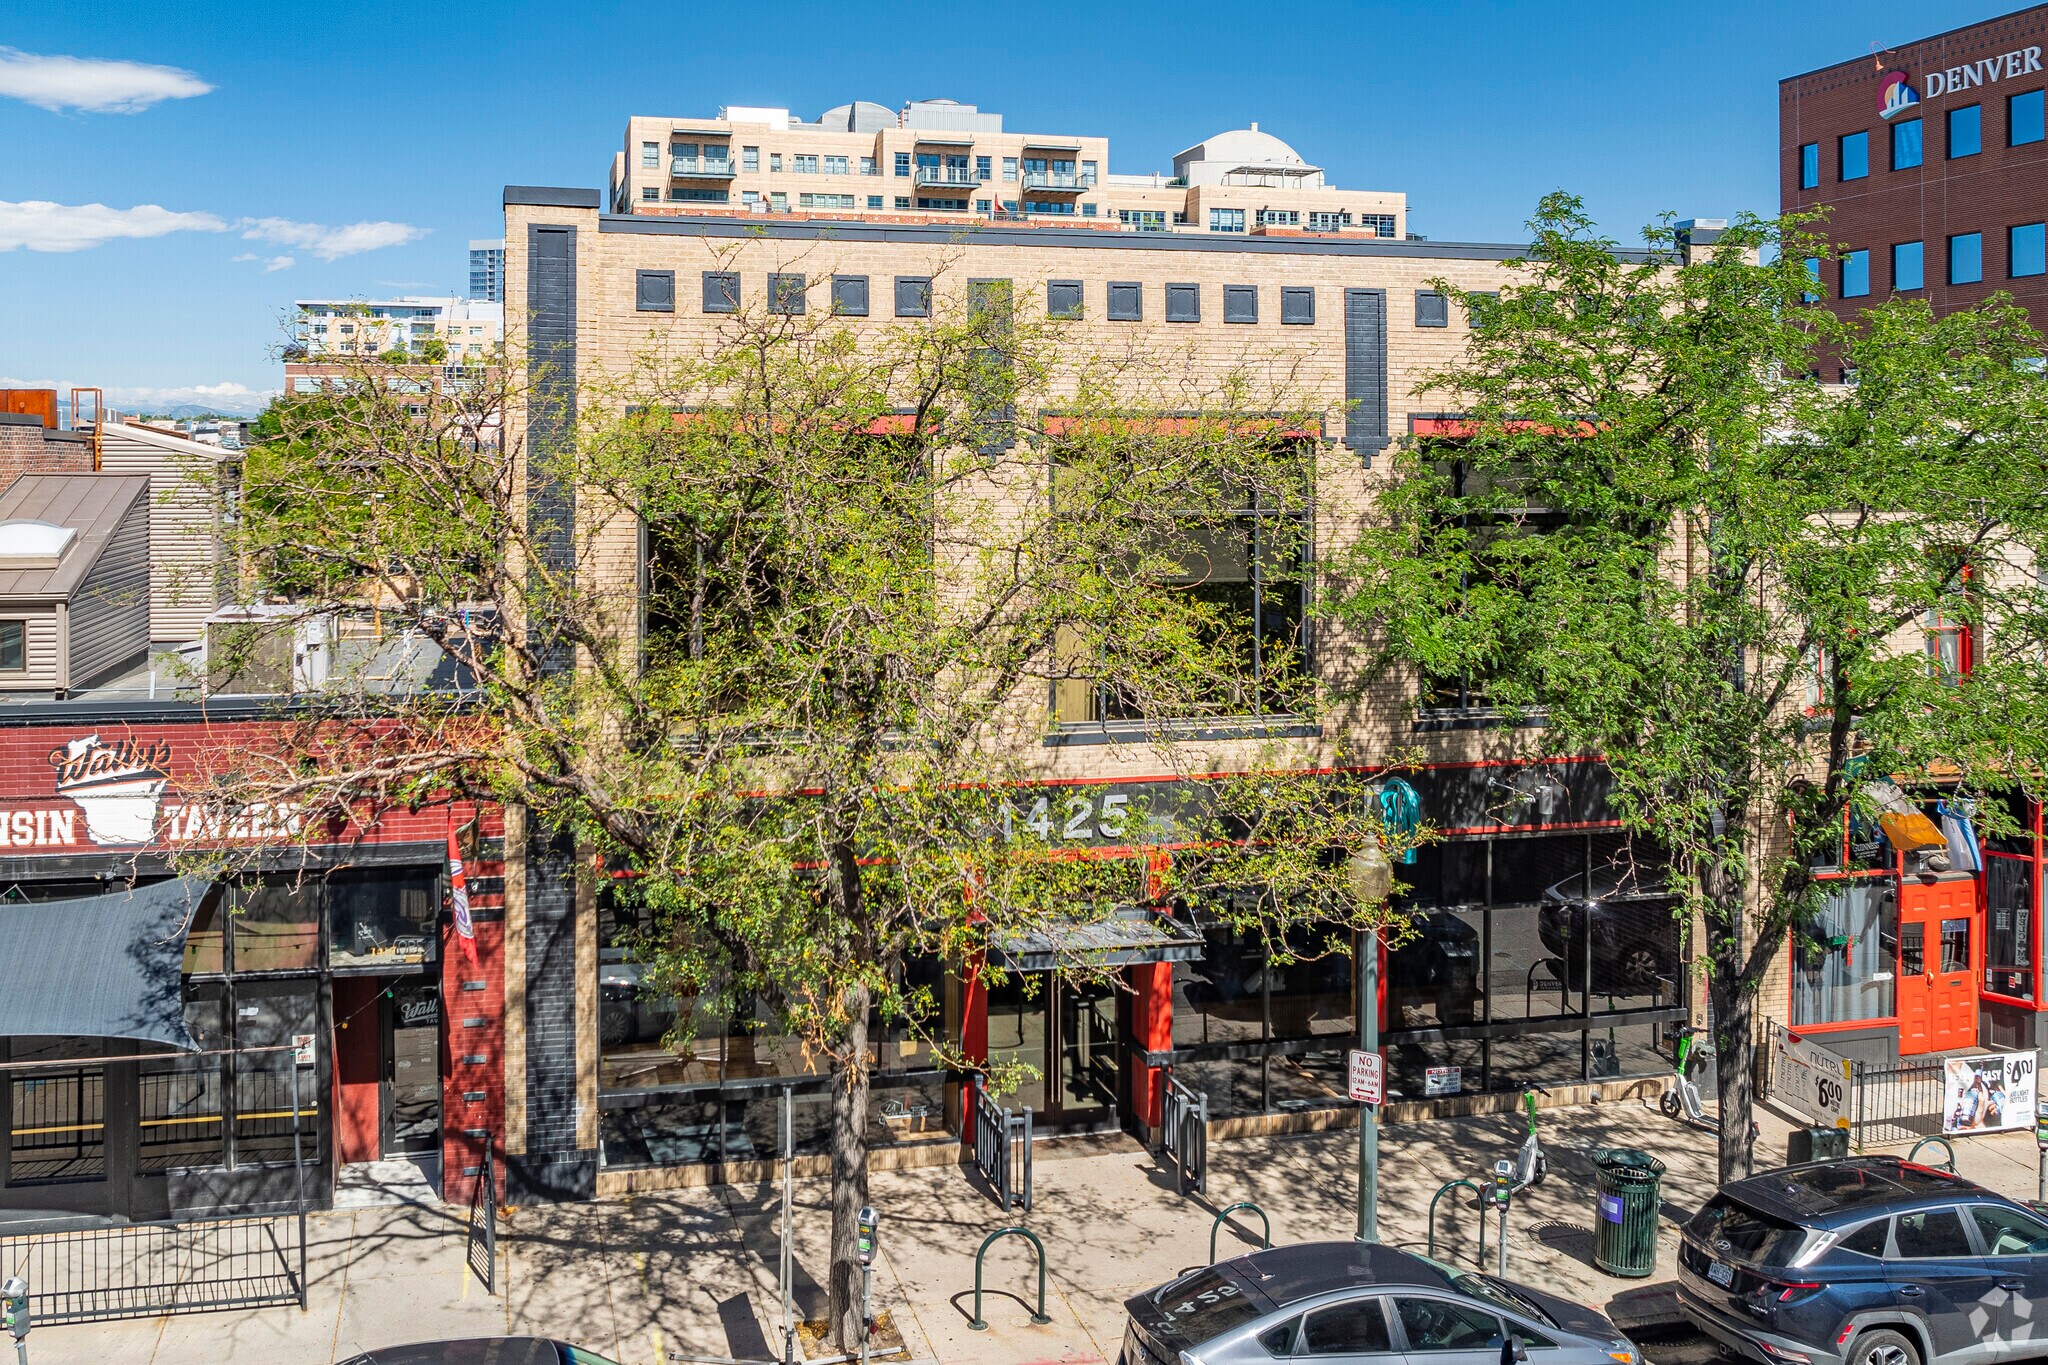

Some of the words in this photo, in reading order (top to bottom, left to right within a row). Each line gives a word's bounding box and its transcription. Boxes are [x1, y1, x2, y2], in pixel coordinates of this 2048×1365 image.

[1925, 46, 2043, 99] DENVER
[999, 794, 1128, 842] 1425
[401, 999, 438, 1019] Wall
[1358, 1056, 1373, 1068] NO
[1353, 1066, 1379, 1080] PARKING
